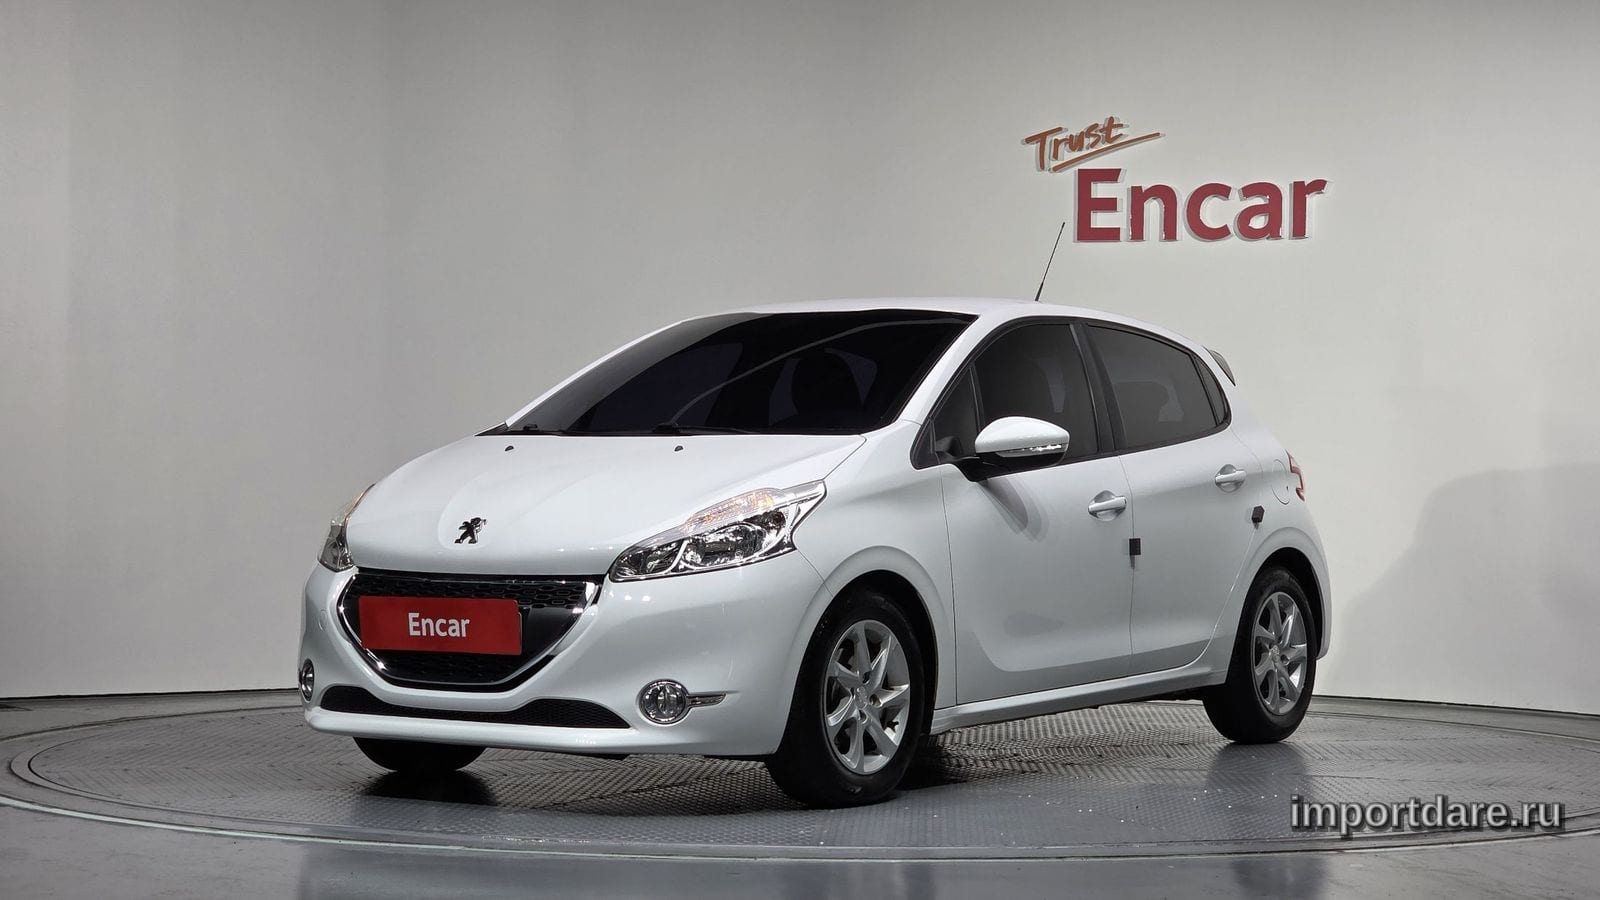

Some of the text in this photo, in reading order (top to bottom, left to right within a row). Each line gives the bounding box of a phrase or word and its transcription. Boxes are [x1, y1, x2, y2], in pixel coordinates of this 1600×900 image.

[1024, 116, 1124, 170] Trust
[1076, 168, 1328, 241] Encar
[407, 612, 470, 637] Encar
